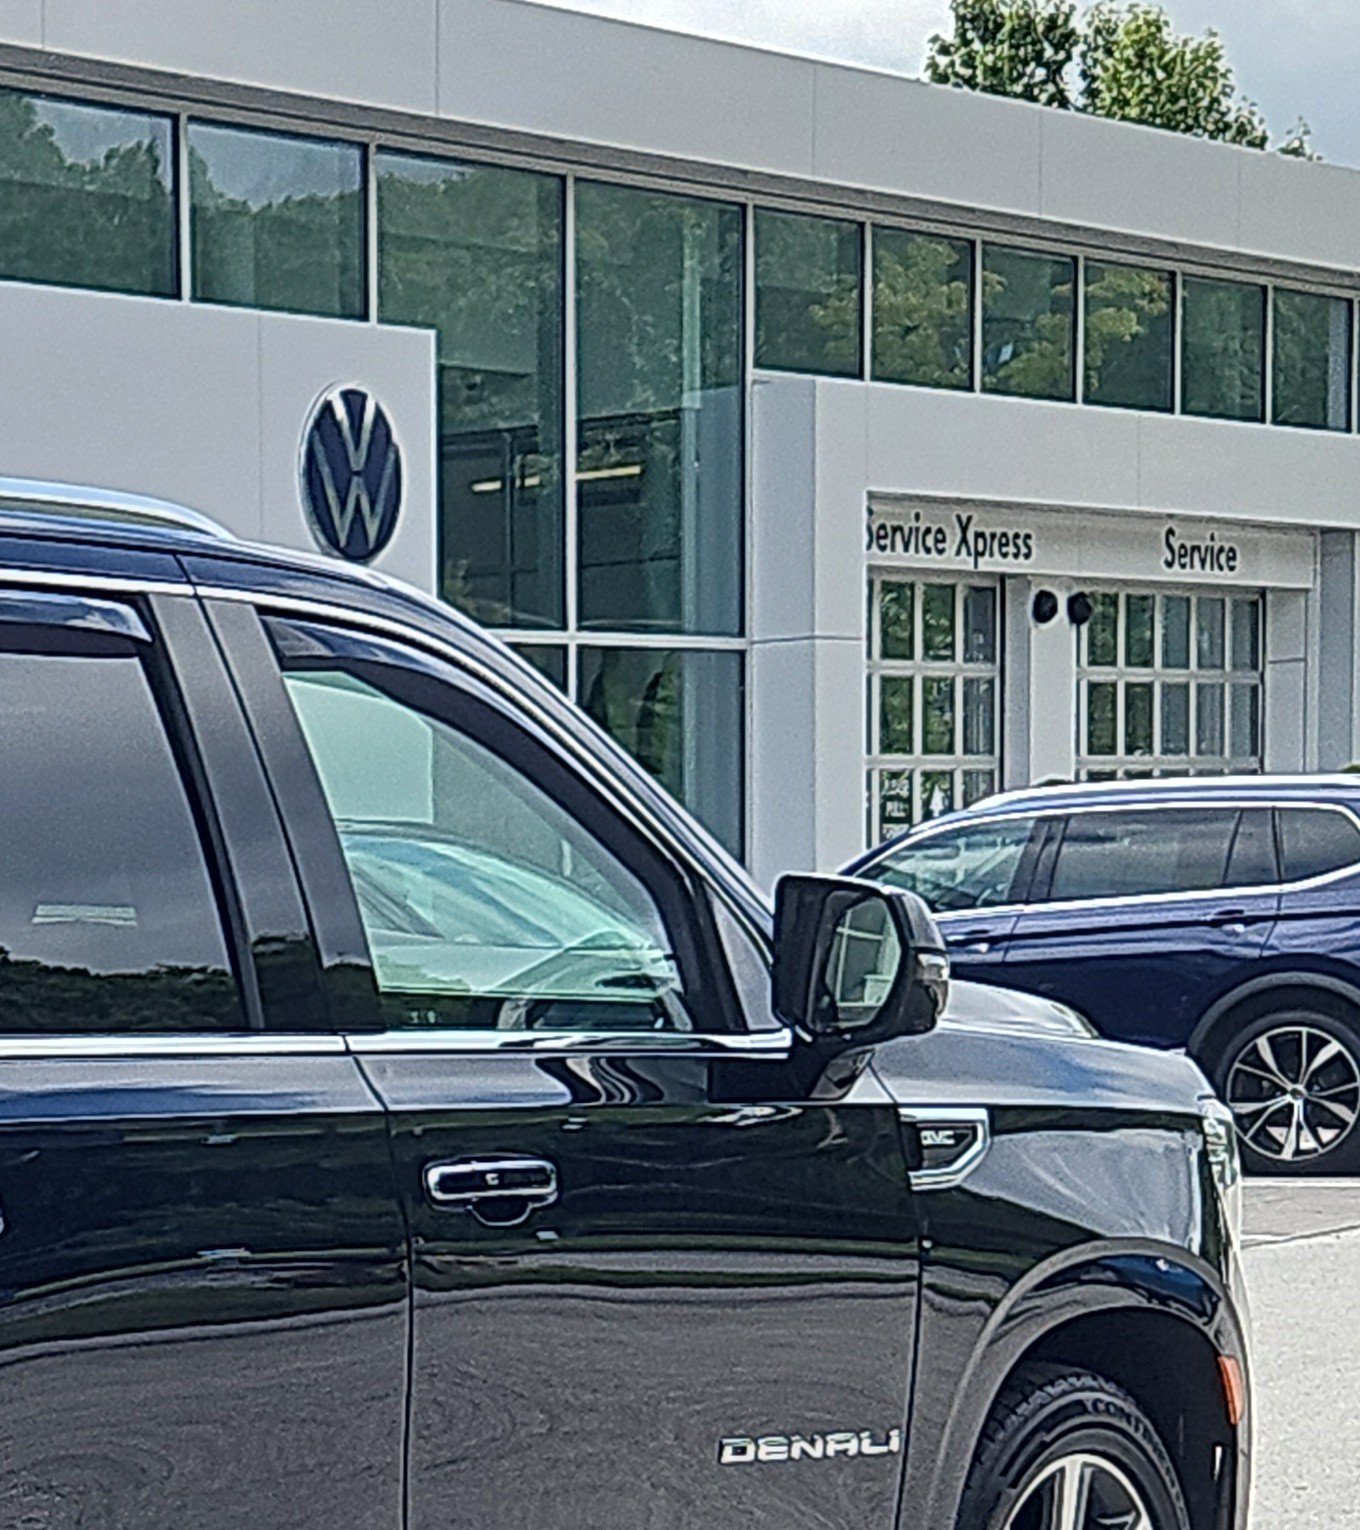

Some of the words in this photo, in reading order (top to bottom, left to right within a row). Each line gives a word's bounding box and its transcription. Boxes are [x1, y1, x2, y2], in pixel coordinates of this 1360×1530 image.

[955, 513, 1032, 569] Xpress
[1163, 526, 1237, 572] Service
[720, 1429, 900, 1464] DENALI
